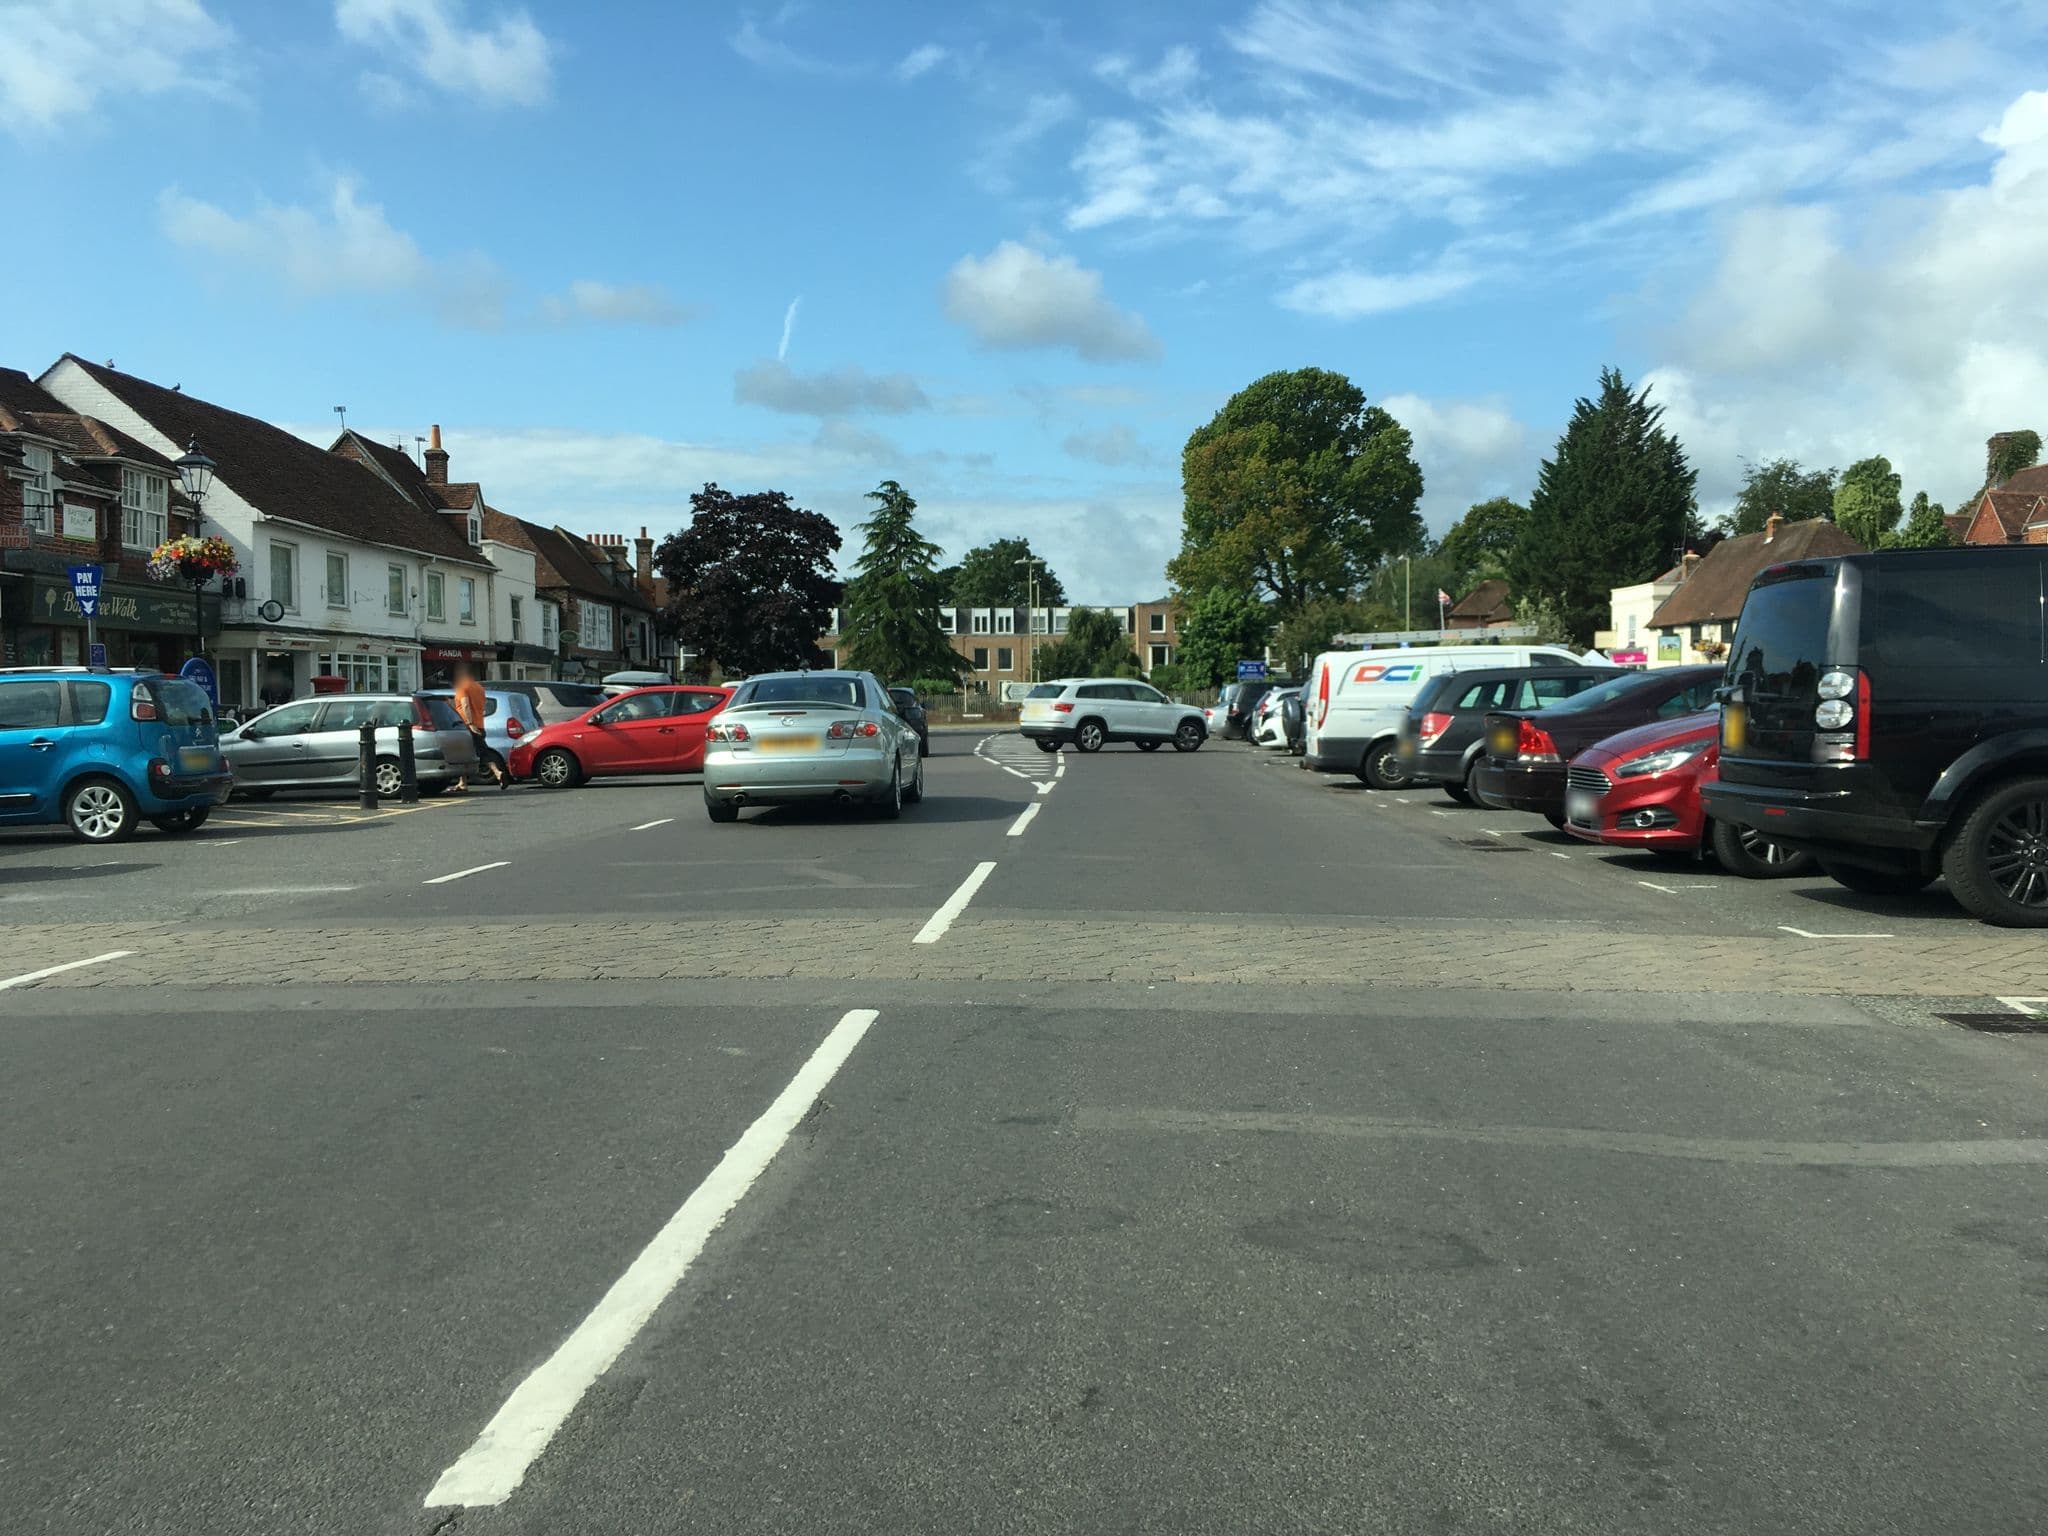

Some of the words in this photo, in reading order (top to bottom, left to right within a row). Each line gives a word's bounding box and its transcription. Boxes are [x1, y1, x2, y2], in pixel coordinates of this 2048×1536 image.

[76, 573, 92, 583] PAY
[75, 586, 97, 596] HERE
[112, 597, 140, 620] Walk
[439, 649, 462, 657] PANDA
